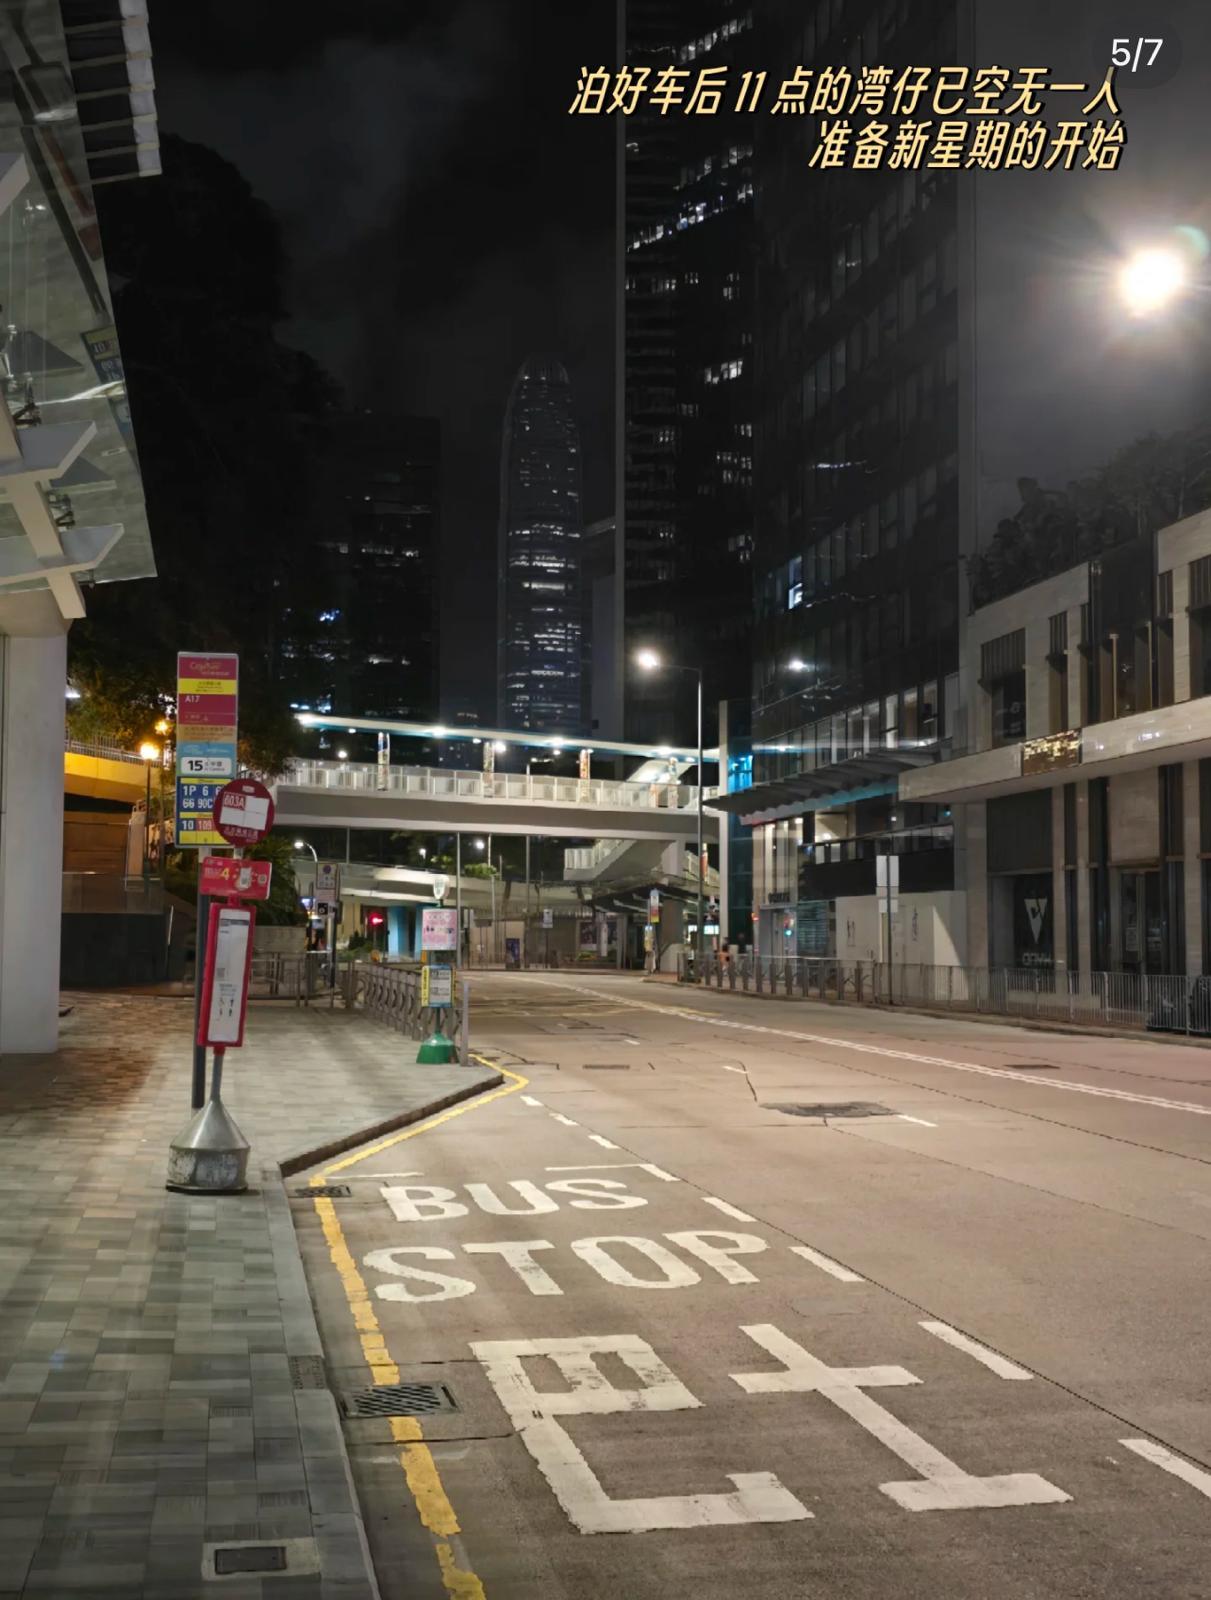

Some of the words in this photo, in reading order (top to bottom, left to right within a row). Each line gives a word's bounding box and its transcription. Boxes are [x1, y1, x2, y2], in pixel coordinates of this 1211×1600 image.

[184, 695, 200, 703] A17
[188, 760, 203, 771] 15
[183, 785, 196, 796] 1P
[202, 785, 208, 796] 6
[182, 798, 194, 809] 66
[198, 798, 213, 809] 90C
[182, 820, 194, 830] 10
[381, 1179, 648, 1222] BUS
[363, 1230, 770, 1302] STOP
[469, 1322, 1074, 1535] 巴士
